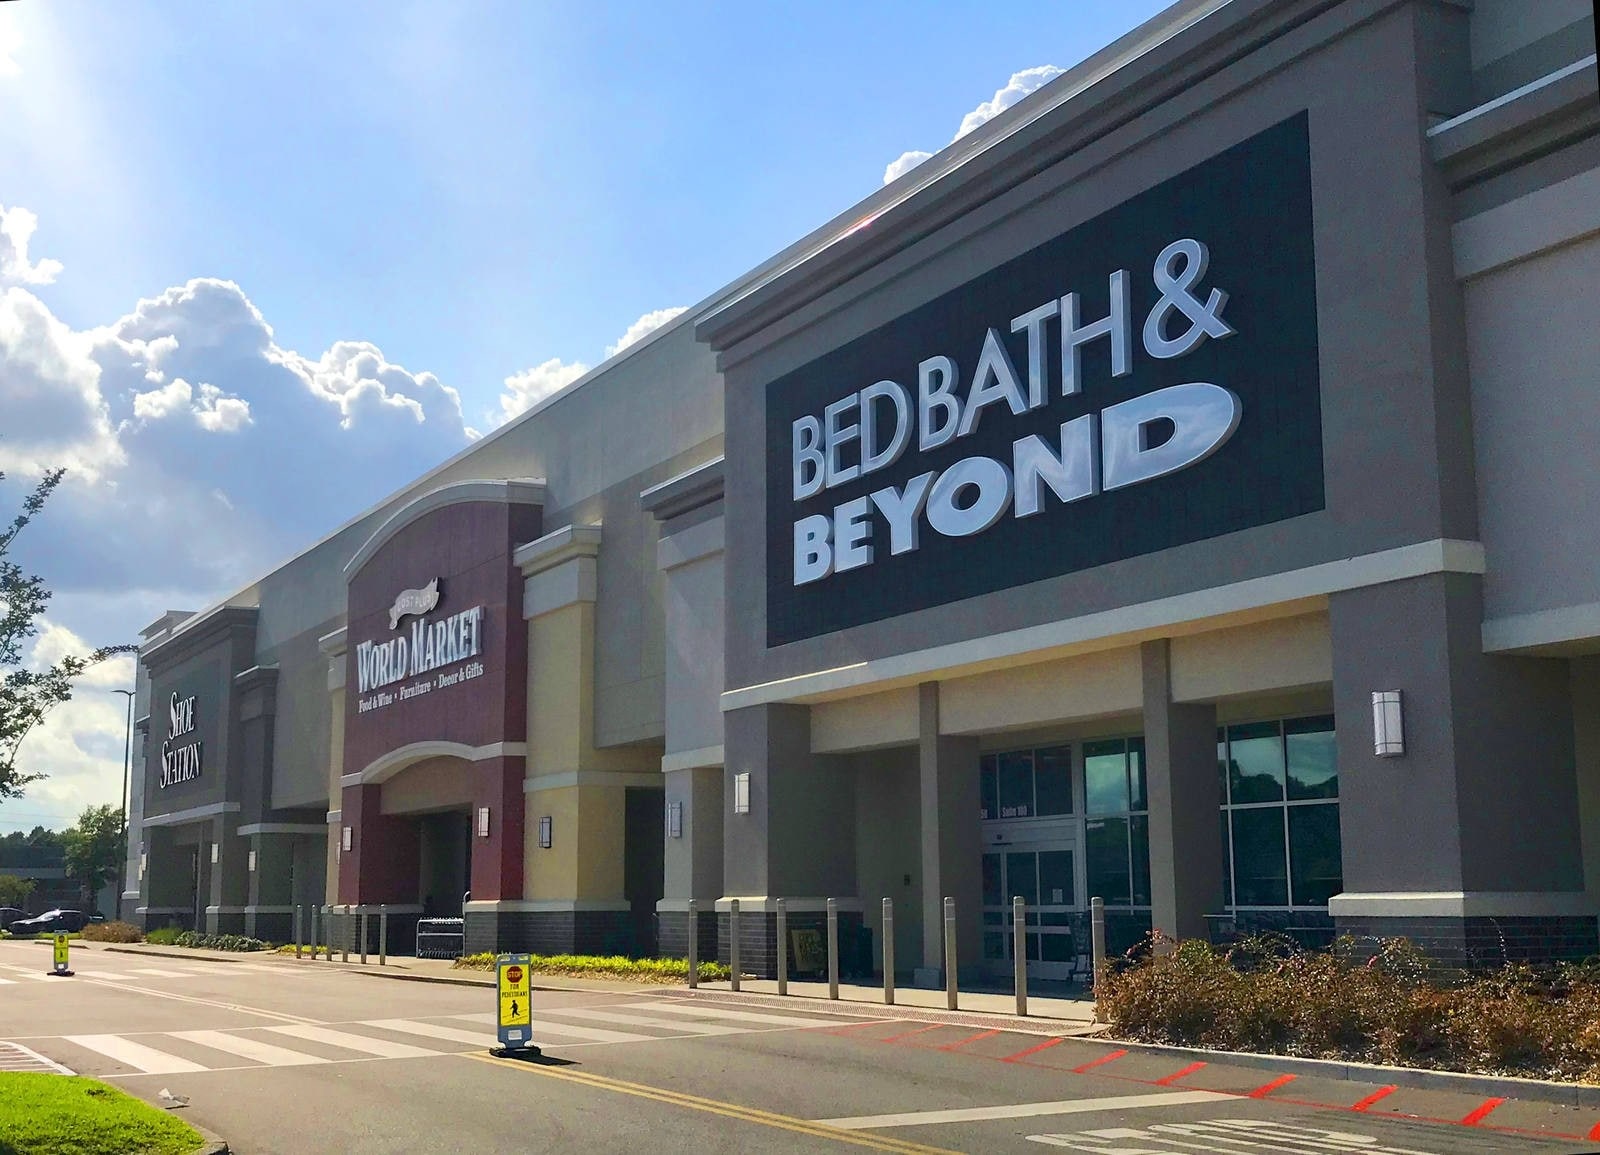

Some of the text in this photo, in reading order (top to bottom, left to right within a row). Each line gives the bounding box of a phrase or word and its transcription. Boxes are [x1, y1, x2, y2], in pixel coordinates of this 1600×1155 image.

[793, 238, 1238, 501] BED BATH &
[793, 382, 1243, 586] BEYOND
[357, 605, 481, 693] WORLD MARKET
[359, 696, 372, 713] Food
[378, 692, 392, 707] Wine
[400, 681, 432, 700] Furniture
[438, 672, 459, 688] Decor
[465, 661, 484, 680] Gifts
[168, 691, 195, 740] SHOE
[160, 740, 201, 789] STATION
[507, 970, 523, 978] STOP
